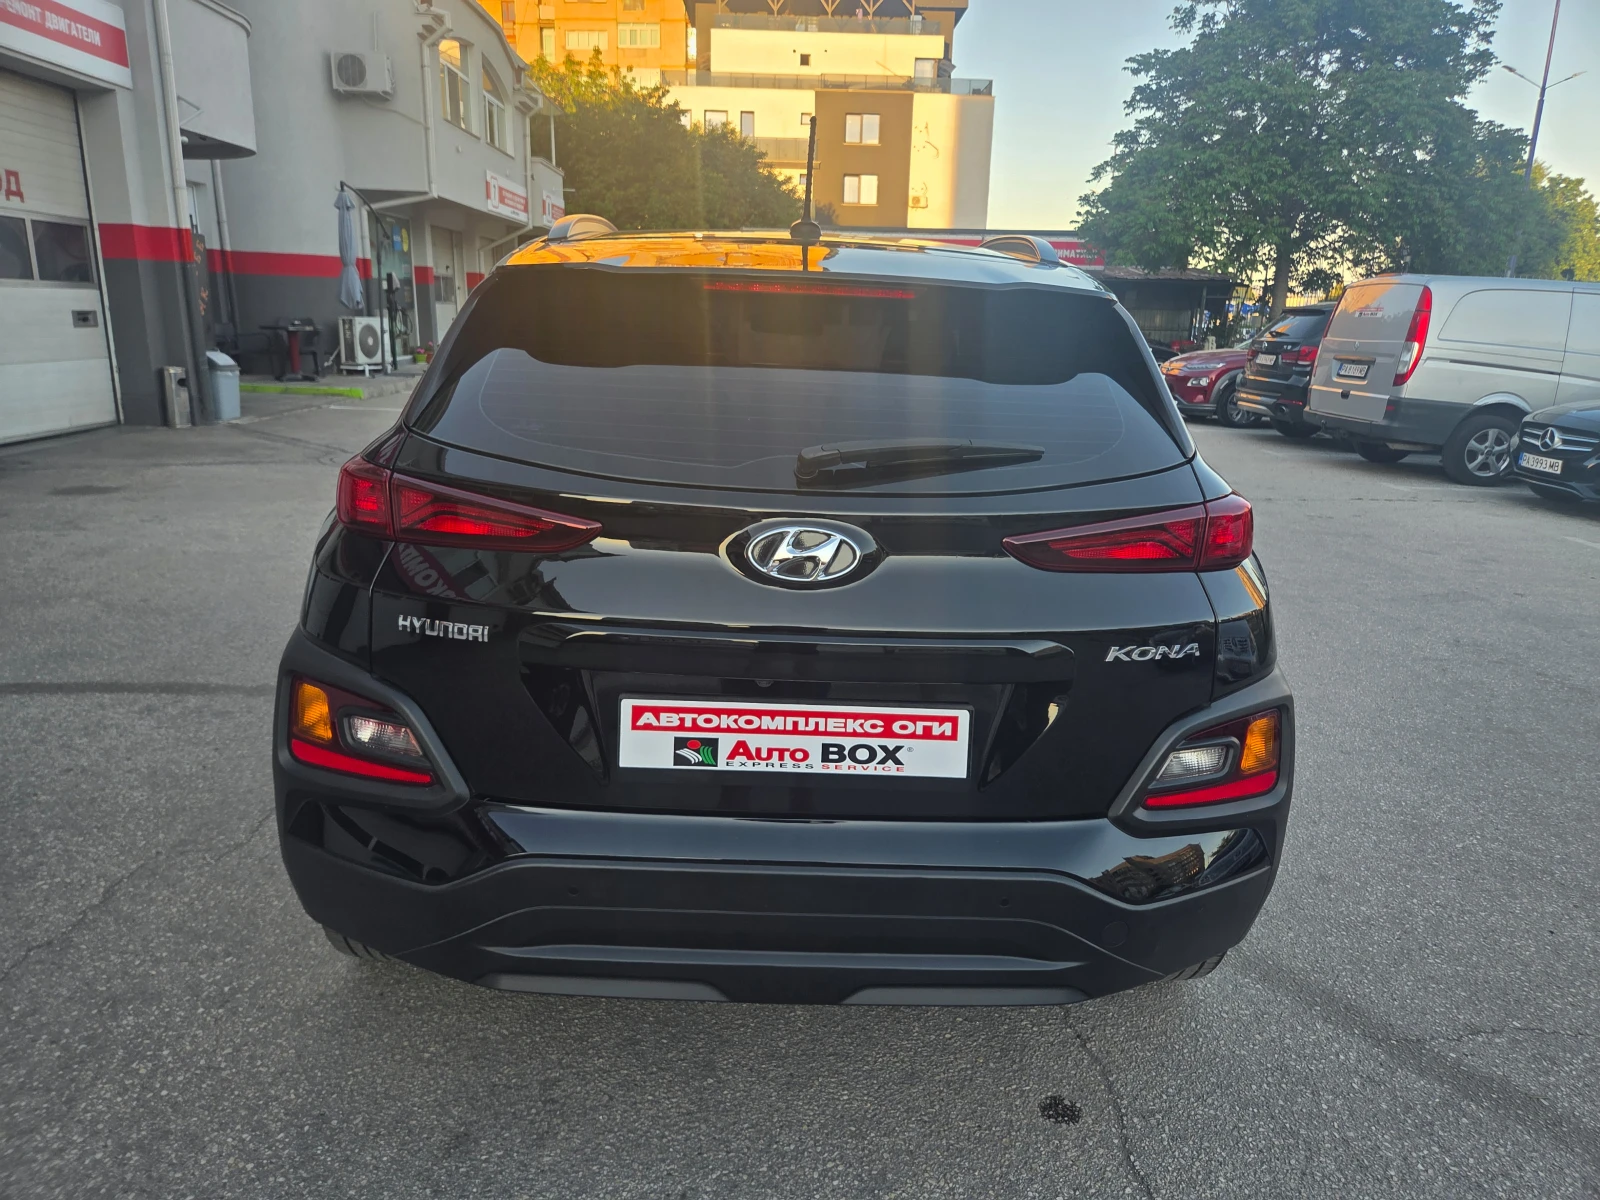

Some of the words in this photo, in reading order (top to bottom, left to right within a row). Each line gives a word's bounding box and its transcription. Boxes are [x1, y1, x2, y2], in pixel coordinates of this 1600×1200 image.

[0, 0, 42, 24] ЕМОНТ
[44, 10, 102, 47] ДВИГАТЕЛИ
[0, 169, 25, 203] Д
[398, 614, 489, 642] HYUNDAI
[1105, 643, 1200, 661] KONA
[636, 712, 885, 734] АВТОКОМПЛЕКС
[892, 720, 952, 736] ОГИ
[726, 761, 814, 769] EXPRESS
[821, 764, 905, 772] SERVICE
